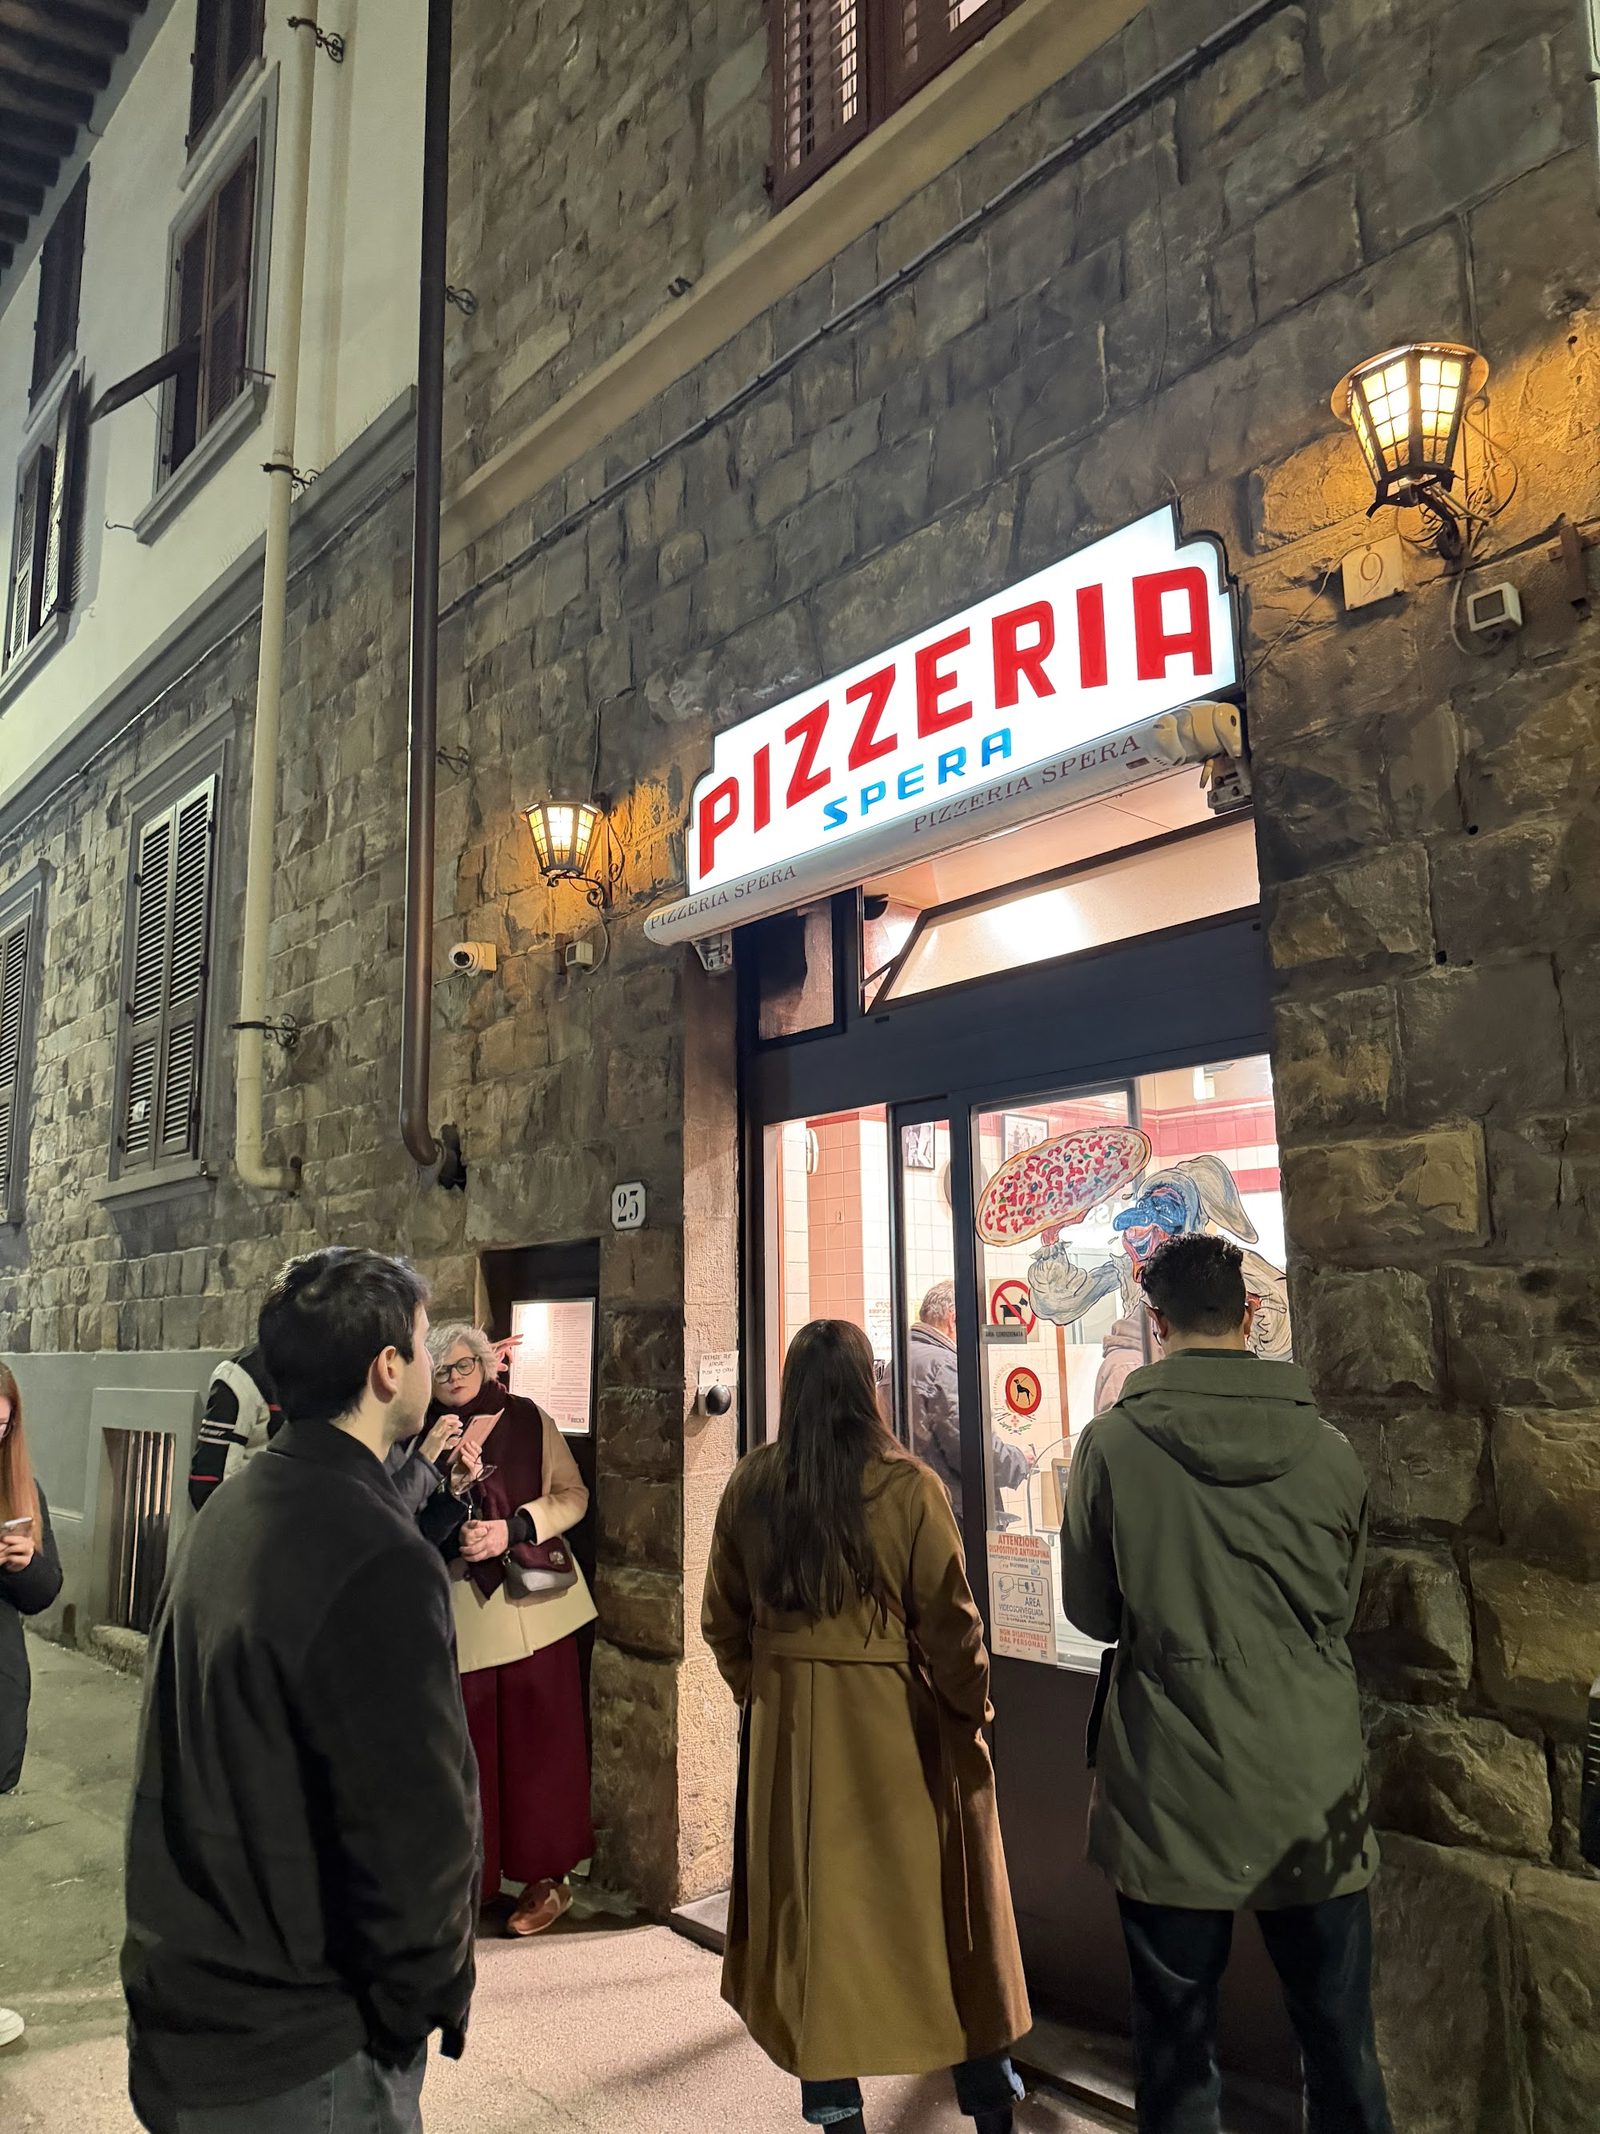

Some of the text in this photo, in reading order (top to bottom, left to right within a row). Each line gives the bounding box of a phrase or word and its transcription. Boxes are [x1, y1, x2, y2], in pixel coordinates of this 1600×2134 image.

[1360, 552, 1383, 598] 9
[700, 567, 1212, 880] PIZZERIA
[824, 728, 1011, 831] SPERA
[912, 735, 1141, 833] PIZZERIA SPERA
[649, 865, 797, 930] PIZZERIA SPERA
[998, 1535, 1039, 1548] ATTENZIONE
[988, 1544, 1050, 1559] DISPOSITIVO ANTIRAPINA
[998, 1603, 1044, 1617] VIDEOSORVEGLIATA
[1024, 1597, 1041, 1608] AREA
[999, 1628, 1048, 1643] NON DISATTIVABILE
[999, 1635, 1012, 1644] DAL
[1012, 1637, 1048, 1650] PERSONALE
